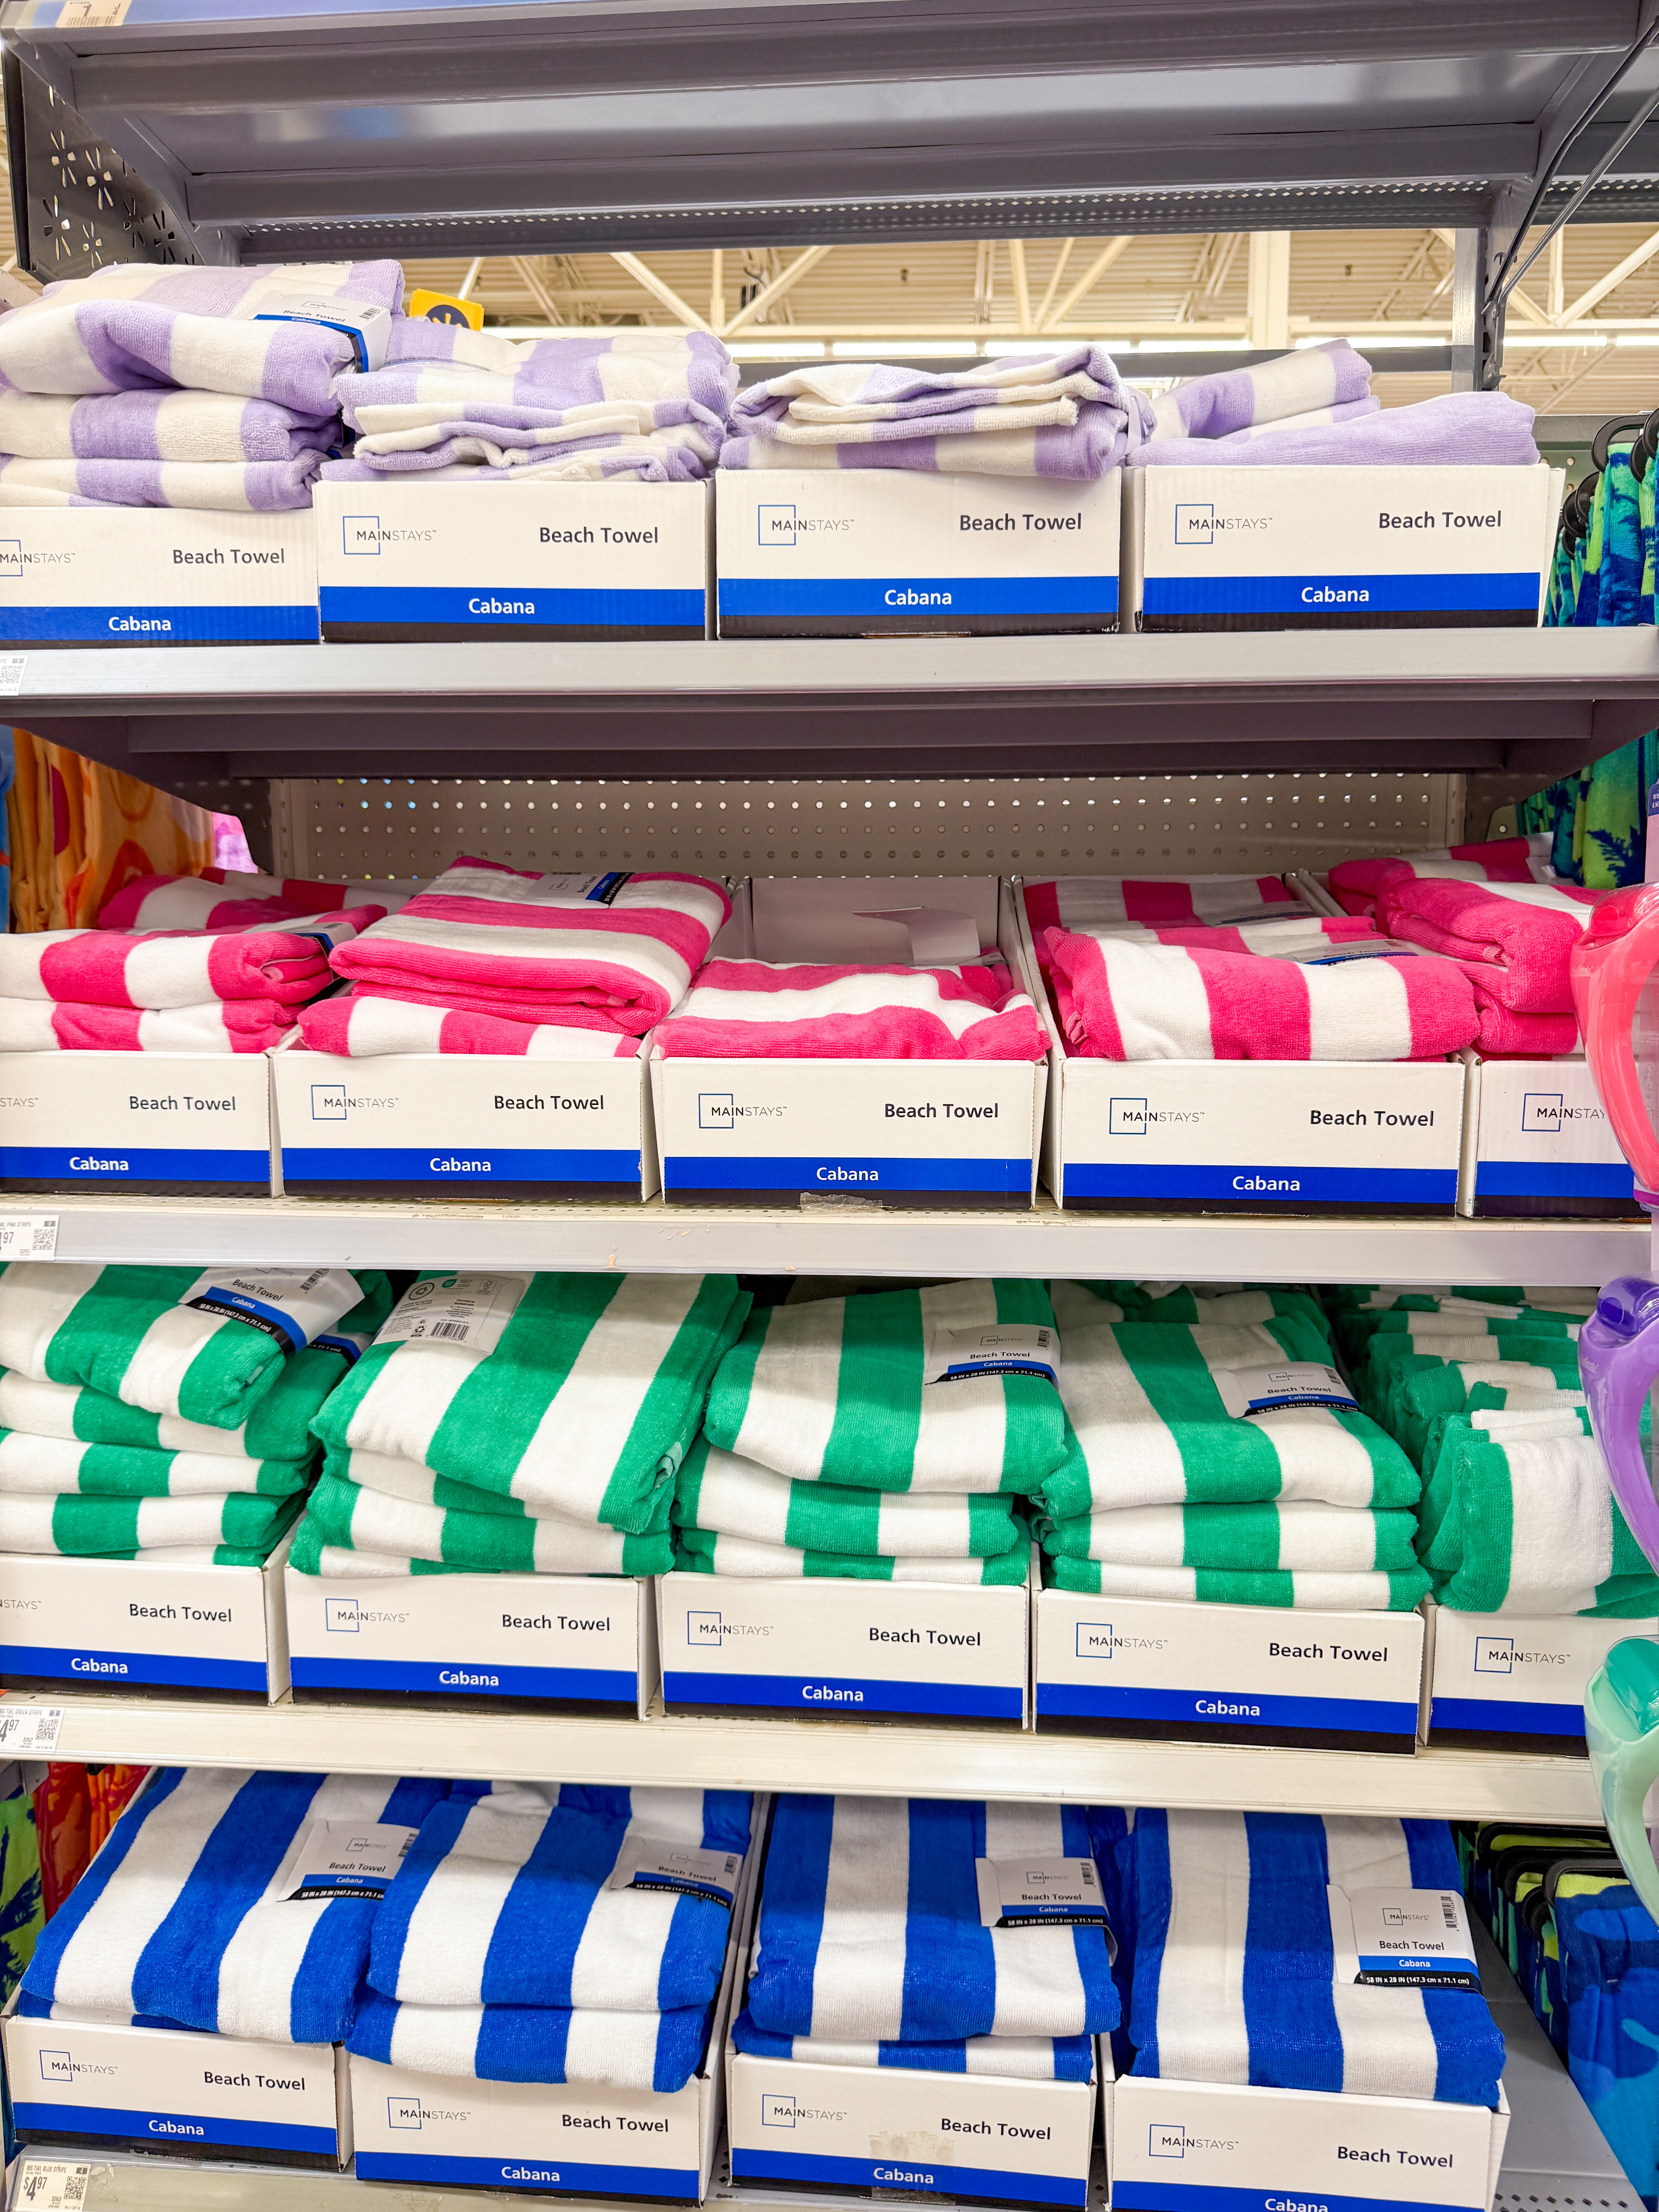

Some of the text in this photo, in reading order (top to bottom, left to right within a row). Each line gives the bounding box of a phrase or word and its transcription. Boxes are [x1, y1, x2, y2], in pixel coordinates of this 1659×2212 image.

[960, 513, 1081, 530] Beach Towel
[1379, 510, 1501, 528] Beach Towel
[540, 527, 658, 543] Beach Towel
[173, 548, 284, 563] Beach Towel
[885, 589, 951, 605] Cabana
[1302, 586, 1369, 602] Cabana
[469, 598, 534, 614] Cabana
[109, 616, 171, 631] Cabana
[130, 1096, 235, 1110] Beach Towel
[495, 1095, 603, 1109] Beach Towel
[885, 1103, 998, 1118] Beach Towel
[1311, 1110, 1433, 1126] Beach Towel
[1537, 1108, 1605, 1119] MAINSTAY
[70, 1156, 129, 1170] Cabana
[430, 1158, 491, 1171] Cabana
[817, 1167, 878, 1180] Cabana
[1233, 1176, 1300, 1191] Cabana
[233, 1279, 283, 1302] Beach Towel
[232, 1297, 255, 1309] Cabana
[130, 1604, 231, 1621] Beach Towel
[503, 1614, 610, 1631] Beach Towel
[870, 1628, 980, 1645] Beach Towel
[1270, 1643, 1387, 1661] Beach Towel
[71, 1658, 128, 1673] Cabana
[439, 1671, 499, 1686] Cabana
[802, 1686, 863, 1702] Cabana
[1196, 1700, 1259, 1716] Cabana
[358, 1863, 386, 1872] Towel
[689, 1872, 716, 1881] Towel
[1379, 1941, 1444, 1950] Beach Towel
[204, 2071, 305, 2090] Beach Towel
[149, 2120, 204, 2135] Cabana
[563, 2115, 668, 2132] Beach Towel
[942, 2119, 1050, 2140] Beach Towel
[1338, 2147, 1452, 2167] Beach Towel
[501, 2167, 560, 2181] Cabana
[874, 2168, 933, 2184] Cabana
[1265, 2198, 1328, 2212] Cabana
